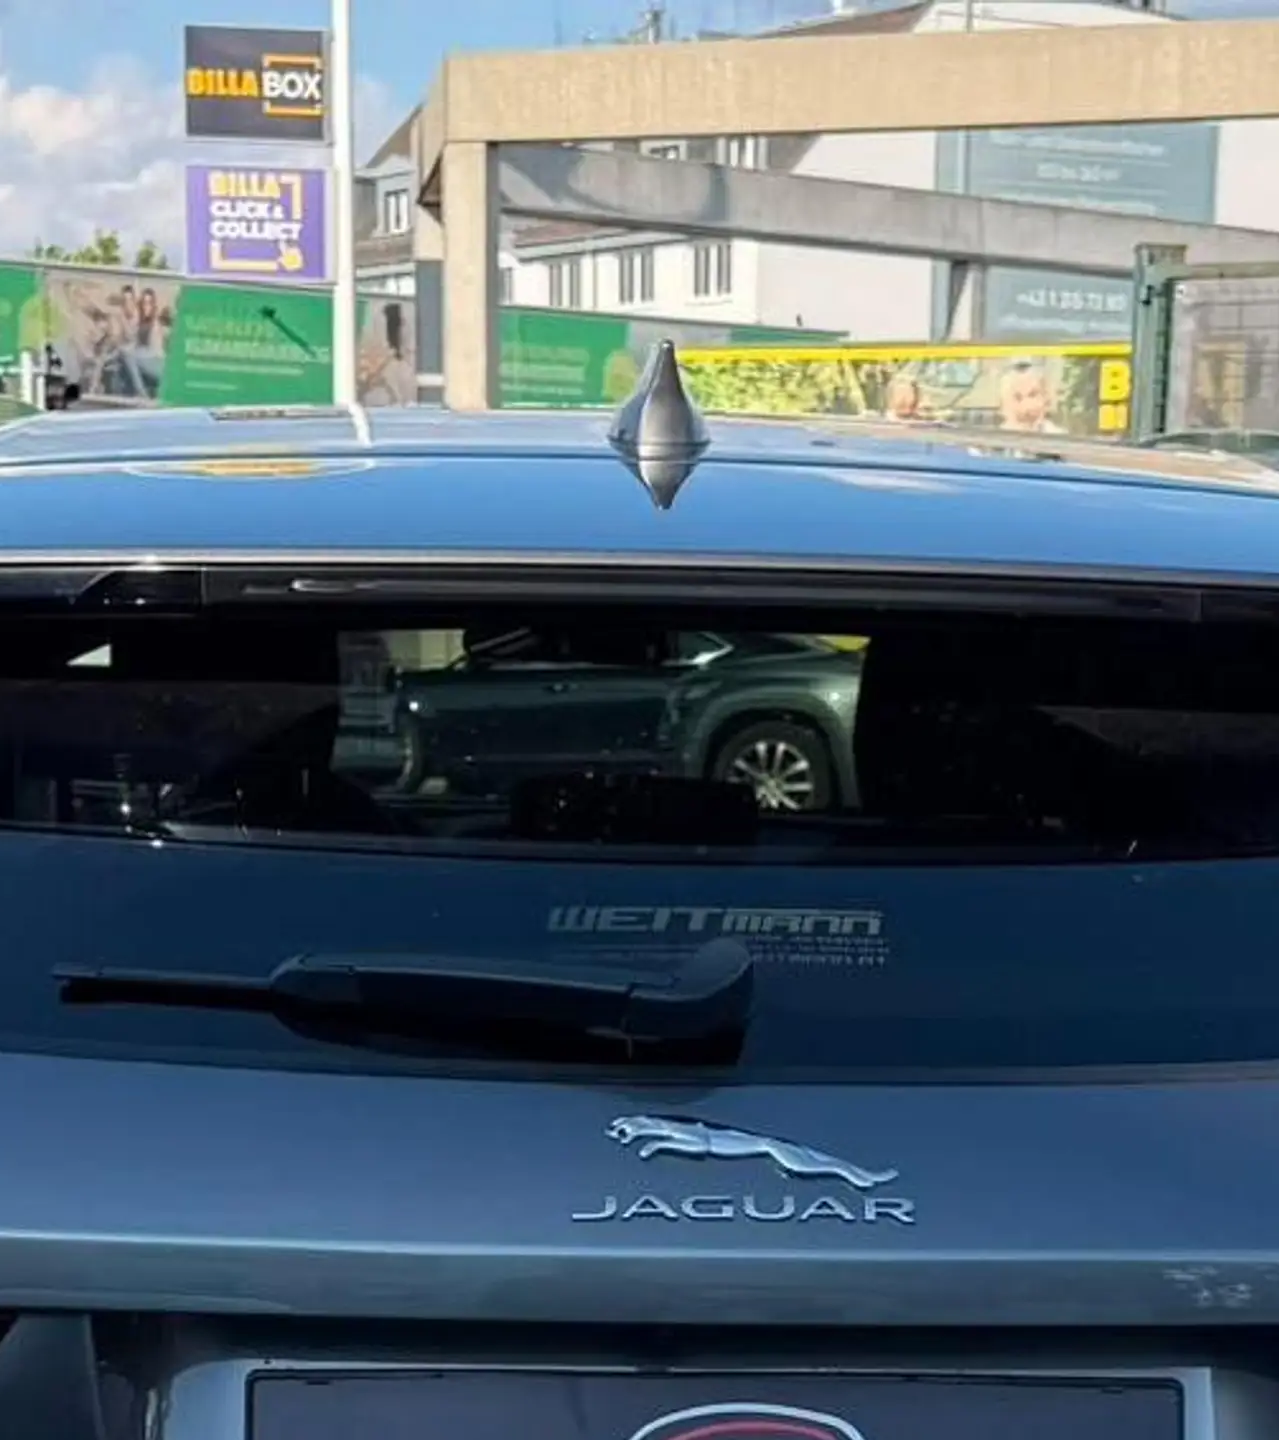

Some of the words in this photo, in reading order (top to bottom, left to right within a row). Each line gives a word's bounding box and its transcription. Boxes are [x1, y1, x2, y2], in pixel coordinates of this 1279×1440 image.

[187, 69, 258, 97] BILLA
[263, 70, 322, 99] BOX
[209, 172, 280, 198] BILLA
[210, 200, 269, 219] CLICK
[210, 220, 302, 240] COLLECT
[572, 1195, 917, 1223] JAGUAR
